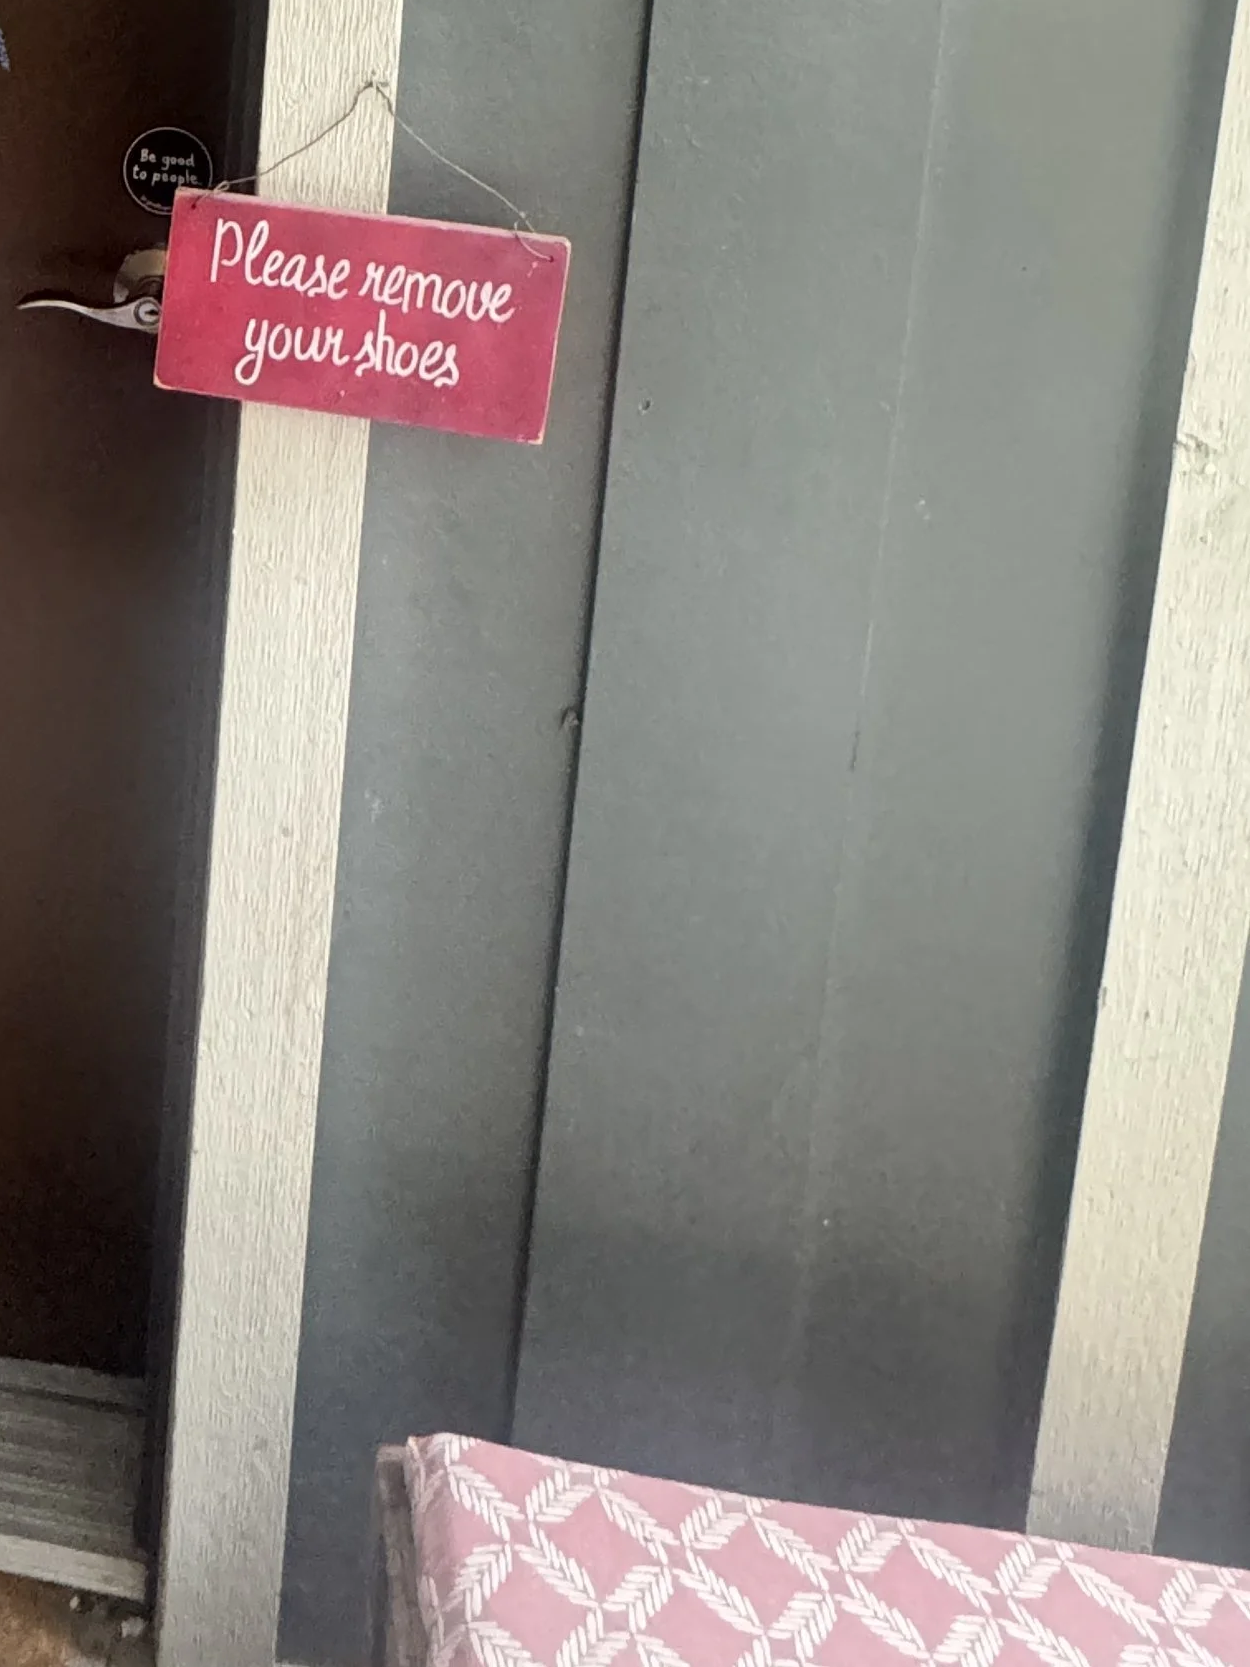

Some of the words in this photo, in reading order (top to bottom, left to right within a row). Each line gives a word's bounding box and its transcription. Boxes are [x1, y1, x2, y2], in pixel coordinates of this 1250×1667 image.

[132, 163, 148, 180] to
[140, 148, 157, 163] Be
[161, 153, 195, 171] good
[209, 217, 352, 302] Please
[357, 260, 516, 324] remove
[233, 317, 350, 387] your
[352, 308, 461, 389] shoes
